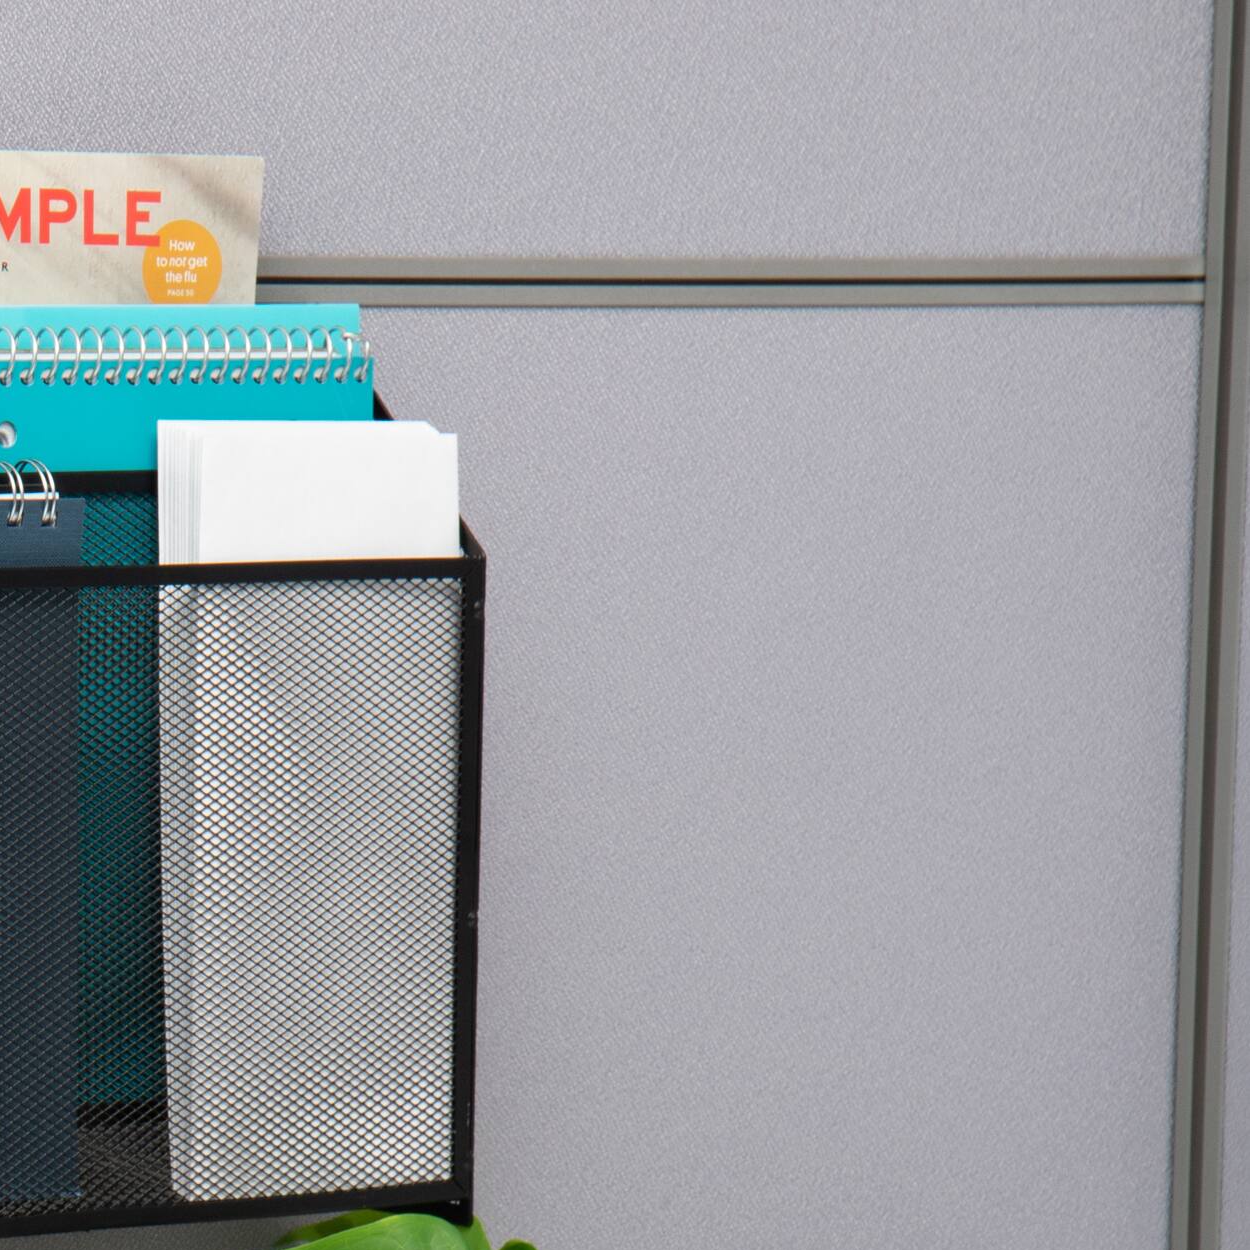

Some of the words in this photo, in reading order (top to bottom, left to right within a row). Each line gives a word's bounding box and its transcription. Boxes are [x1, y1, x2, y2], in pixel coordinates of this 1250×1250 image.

[169, 239, 196, 251] How
[156, 256, 168, 267] to
[169, 256, 186, 267] not
[188, 256, 208, 270] get
[166, 272, 183, 283] the
[184, 271, 198, 283] flu
